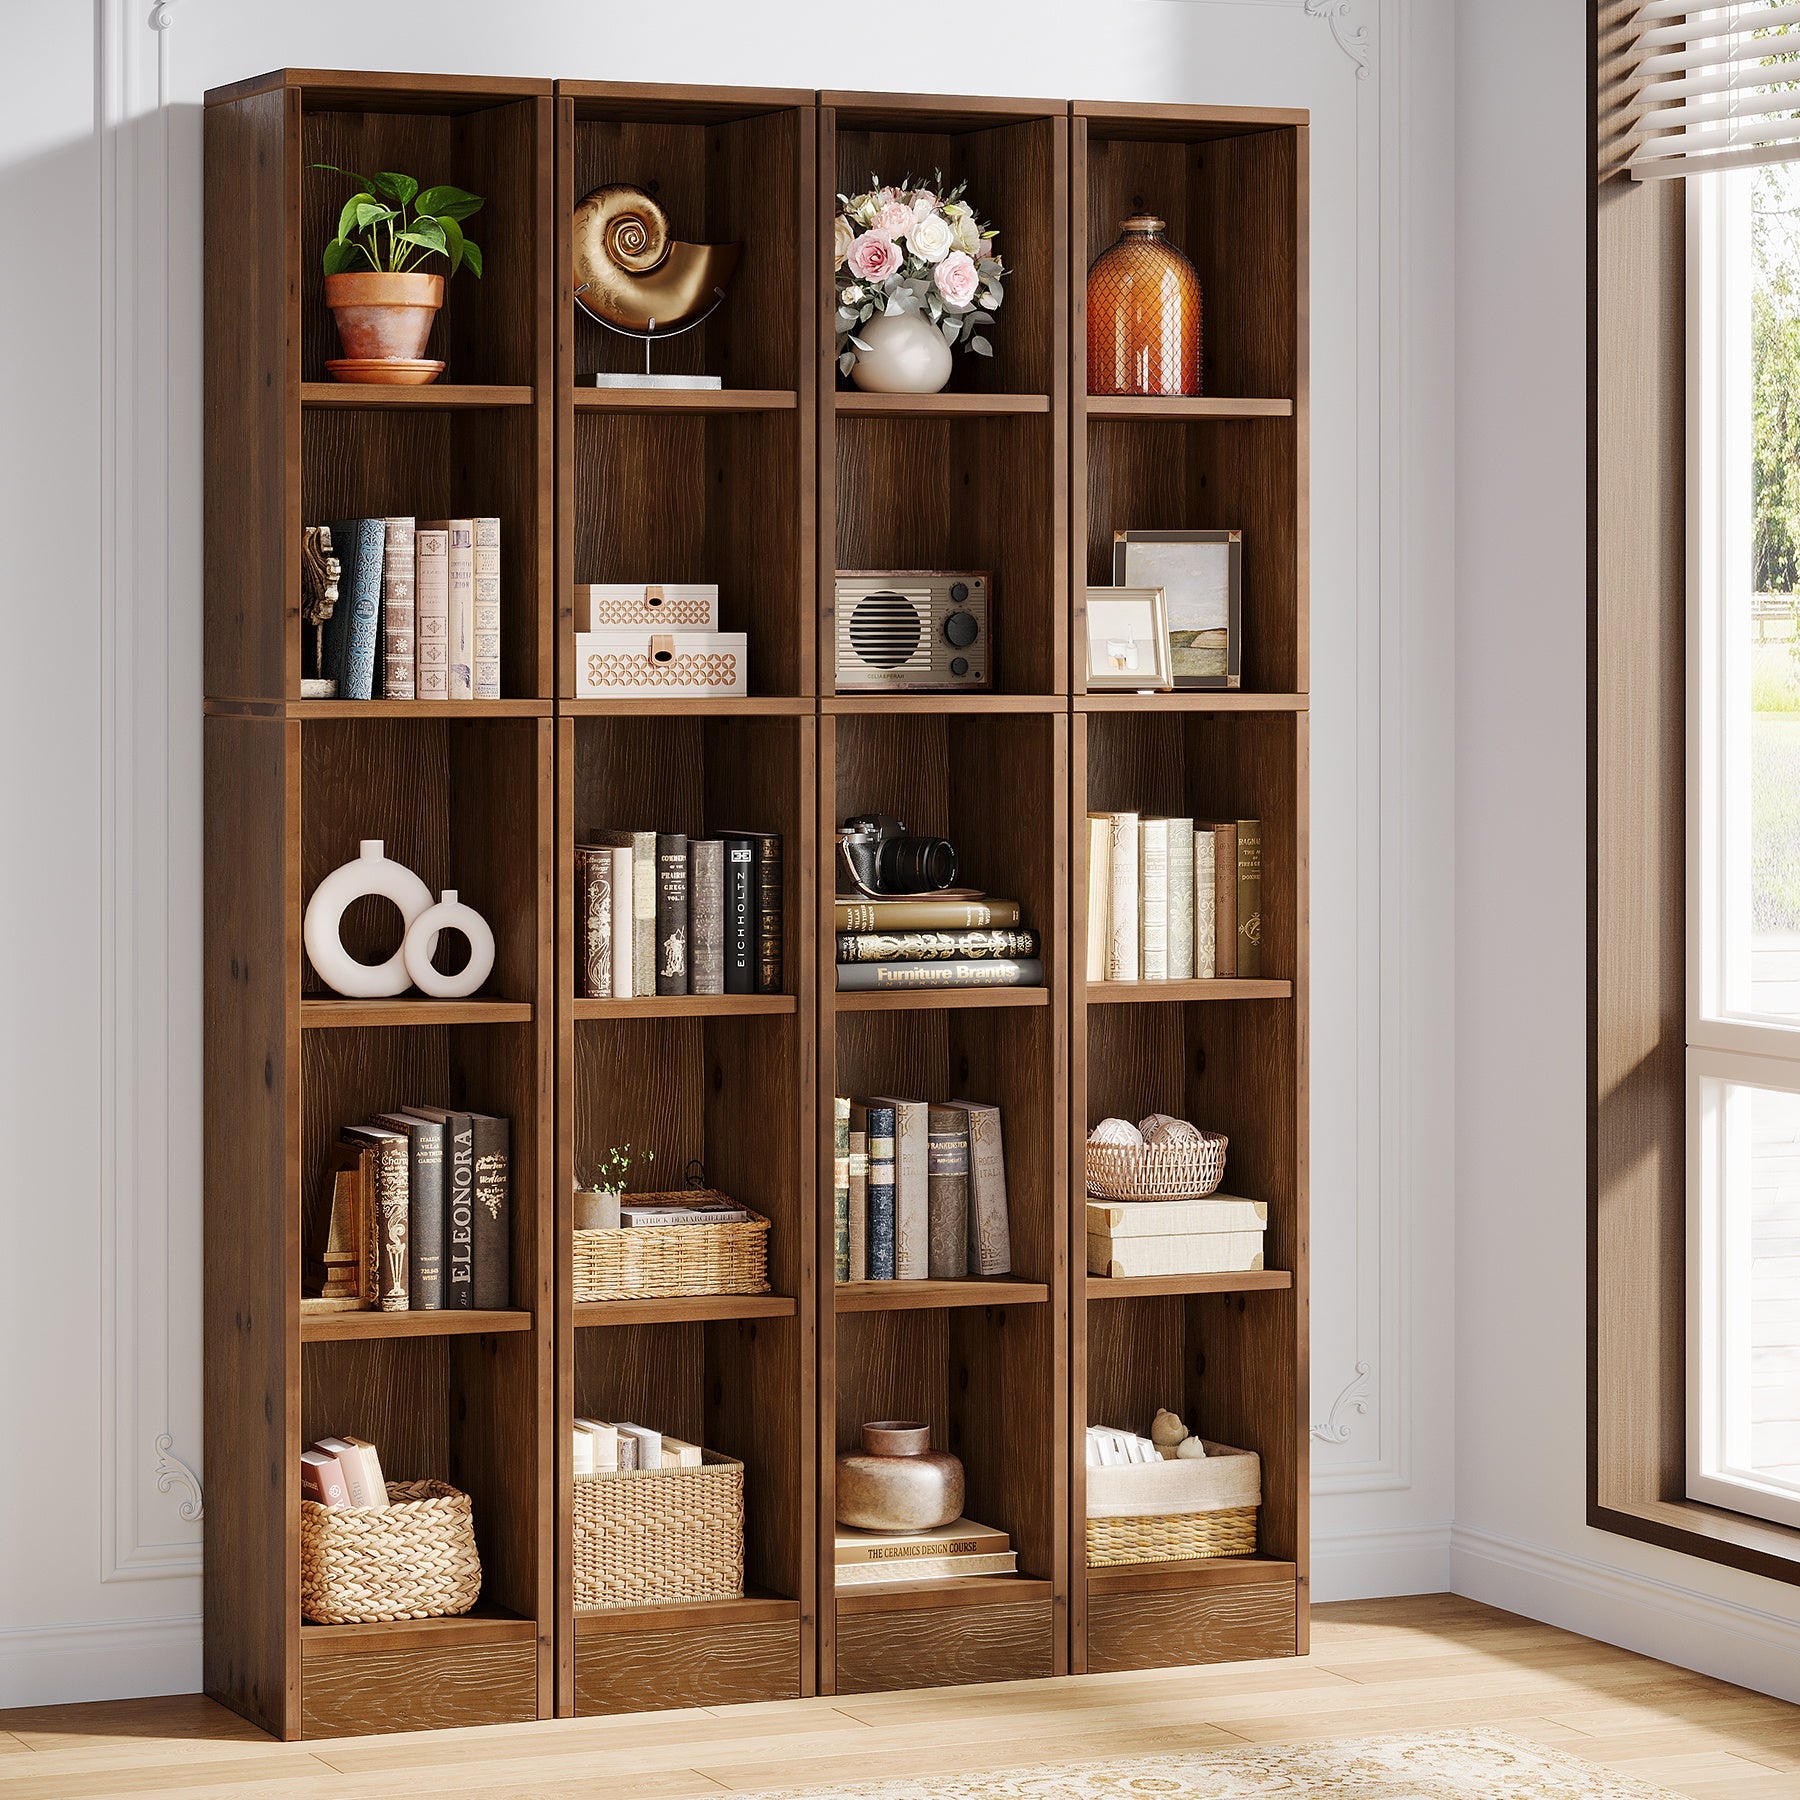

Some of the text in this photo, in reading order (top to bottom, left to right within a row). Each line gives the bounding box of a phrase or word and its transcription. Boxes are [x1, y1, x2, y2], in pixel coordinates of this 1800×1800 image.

[737, 871, 745, 968] EICHHOLTZ
[877, 964, 1016, 981] Furniture Brands
[877, 978, 1015, 987] INTERNATIONAL
[452, 1128, 472, 1284] ELEONORA
[636, 1214, 734, 1225] PATRICK DEMARCHELIER
[868, 1541, 977, 1559] THE CERAMICS DESIGN COURSE
